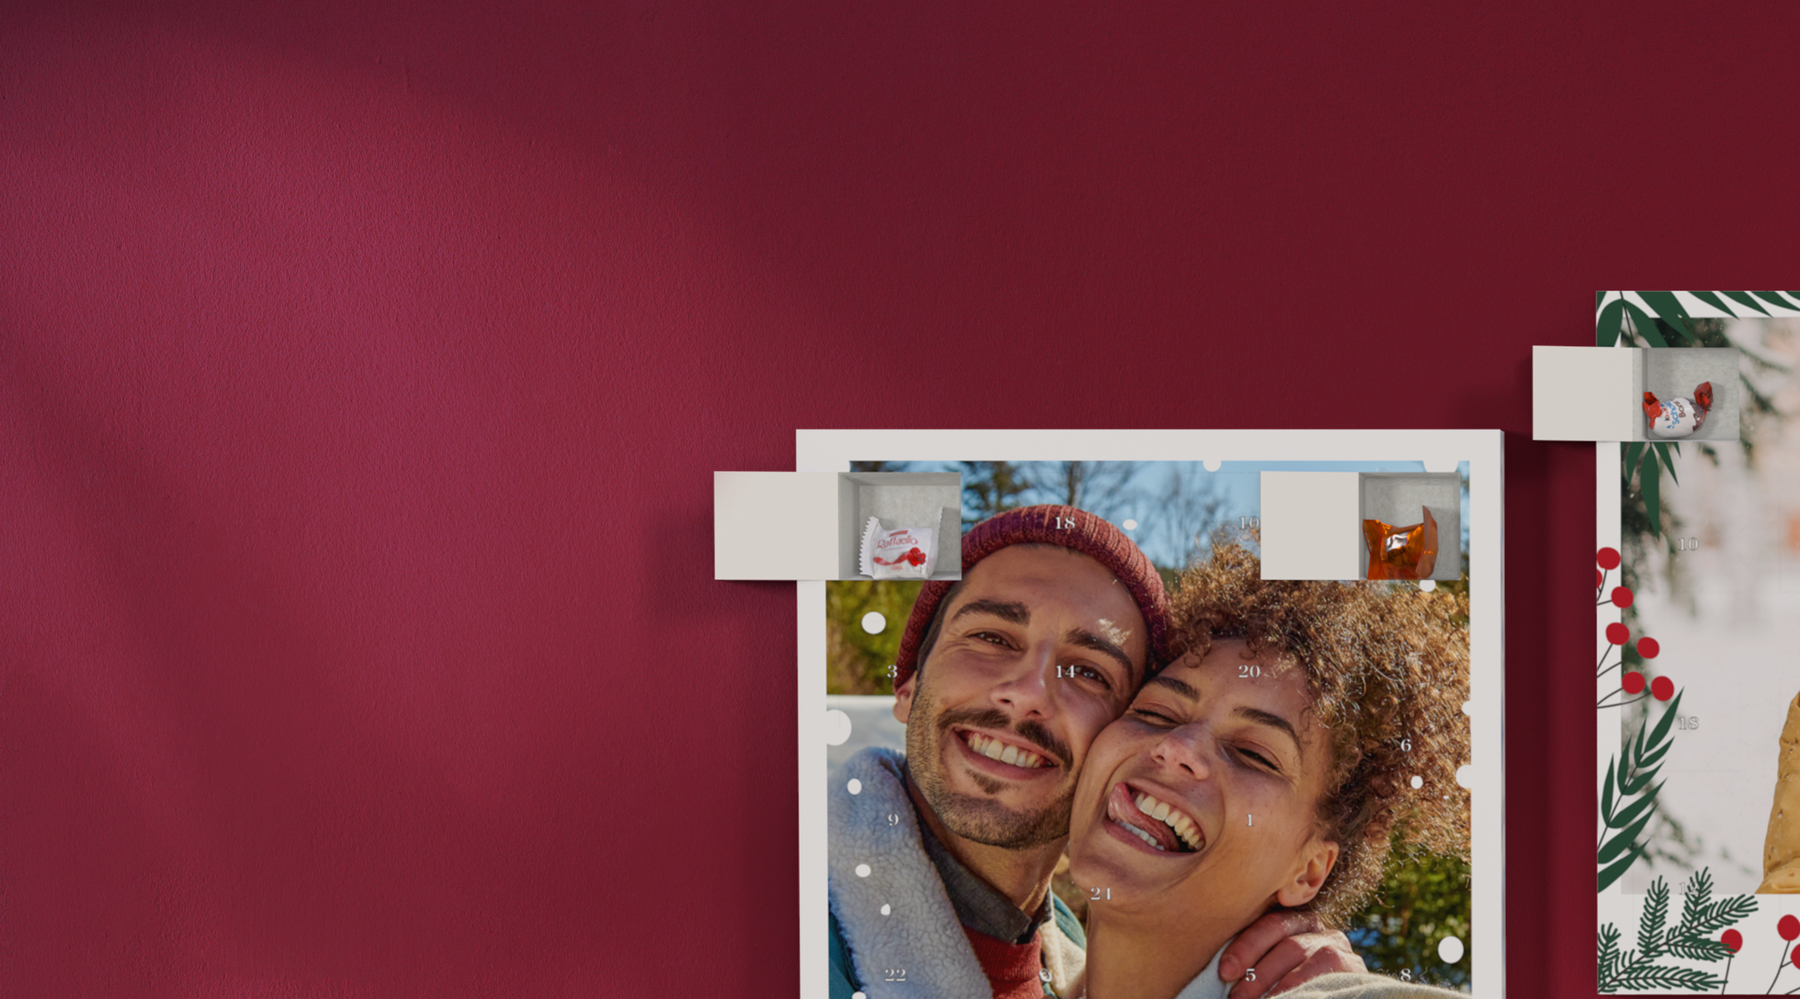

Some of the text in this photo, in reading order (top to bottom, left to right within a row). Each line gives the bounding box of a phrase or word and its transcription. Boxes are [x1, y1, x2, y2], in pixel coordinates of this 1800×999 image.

[1054, 516, 1076, 530] 18
[1239, 516, 1261, 530] 10
[877, 535, 918, 549] Raffaello
[1677, 537, 1699, 551] 10
[886, 664, 898, 679] 3
[1055, 664, 1077, 679] 14
[1238, 664, 1261, 679] 20
[1678, 716, 1700, 730] 18
[1400, 738, 1412, 753] 6
[888, 813, 899, 827] 9
[1246, 813, 1255, 827] 1
[1090, 887, 1113, 901] 24
[884, 968, 906, 982] 22
[1245, 968, 1256, 982] 5
[1400, 968, 1412, 982] 8
